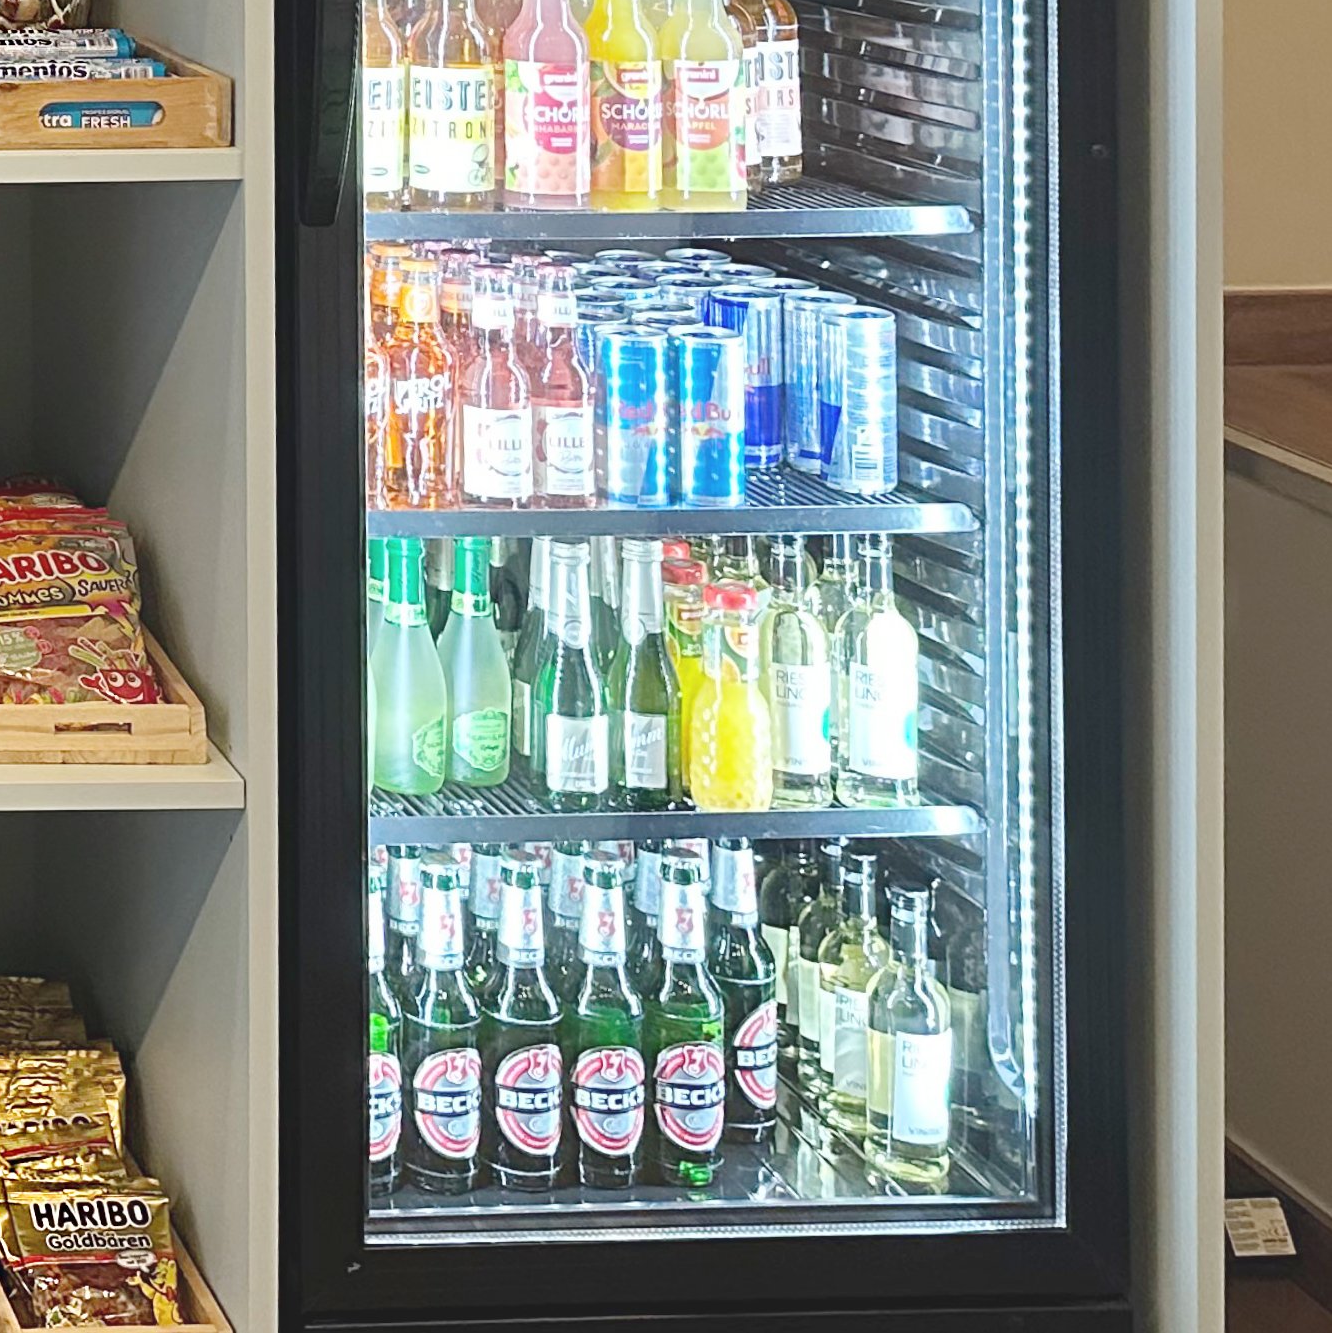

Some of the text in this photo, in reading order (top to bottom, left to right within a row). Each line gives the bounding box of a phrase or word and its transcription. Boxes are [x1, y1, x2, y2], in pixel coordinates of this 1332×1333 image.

[81, 116, 131, 129] FRESH
[31, 1198, 150, 1231] HARIBO
[46, 1233, 151, 1252] Goldbären
